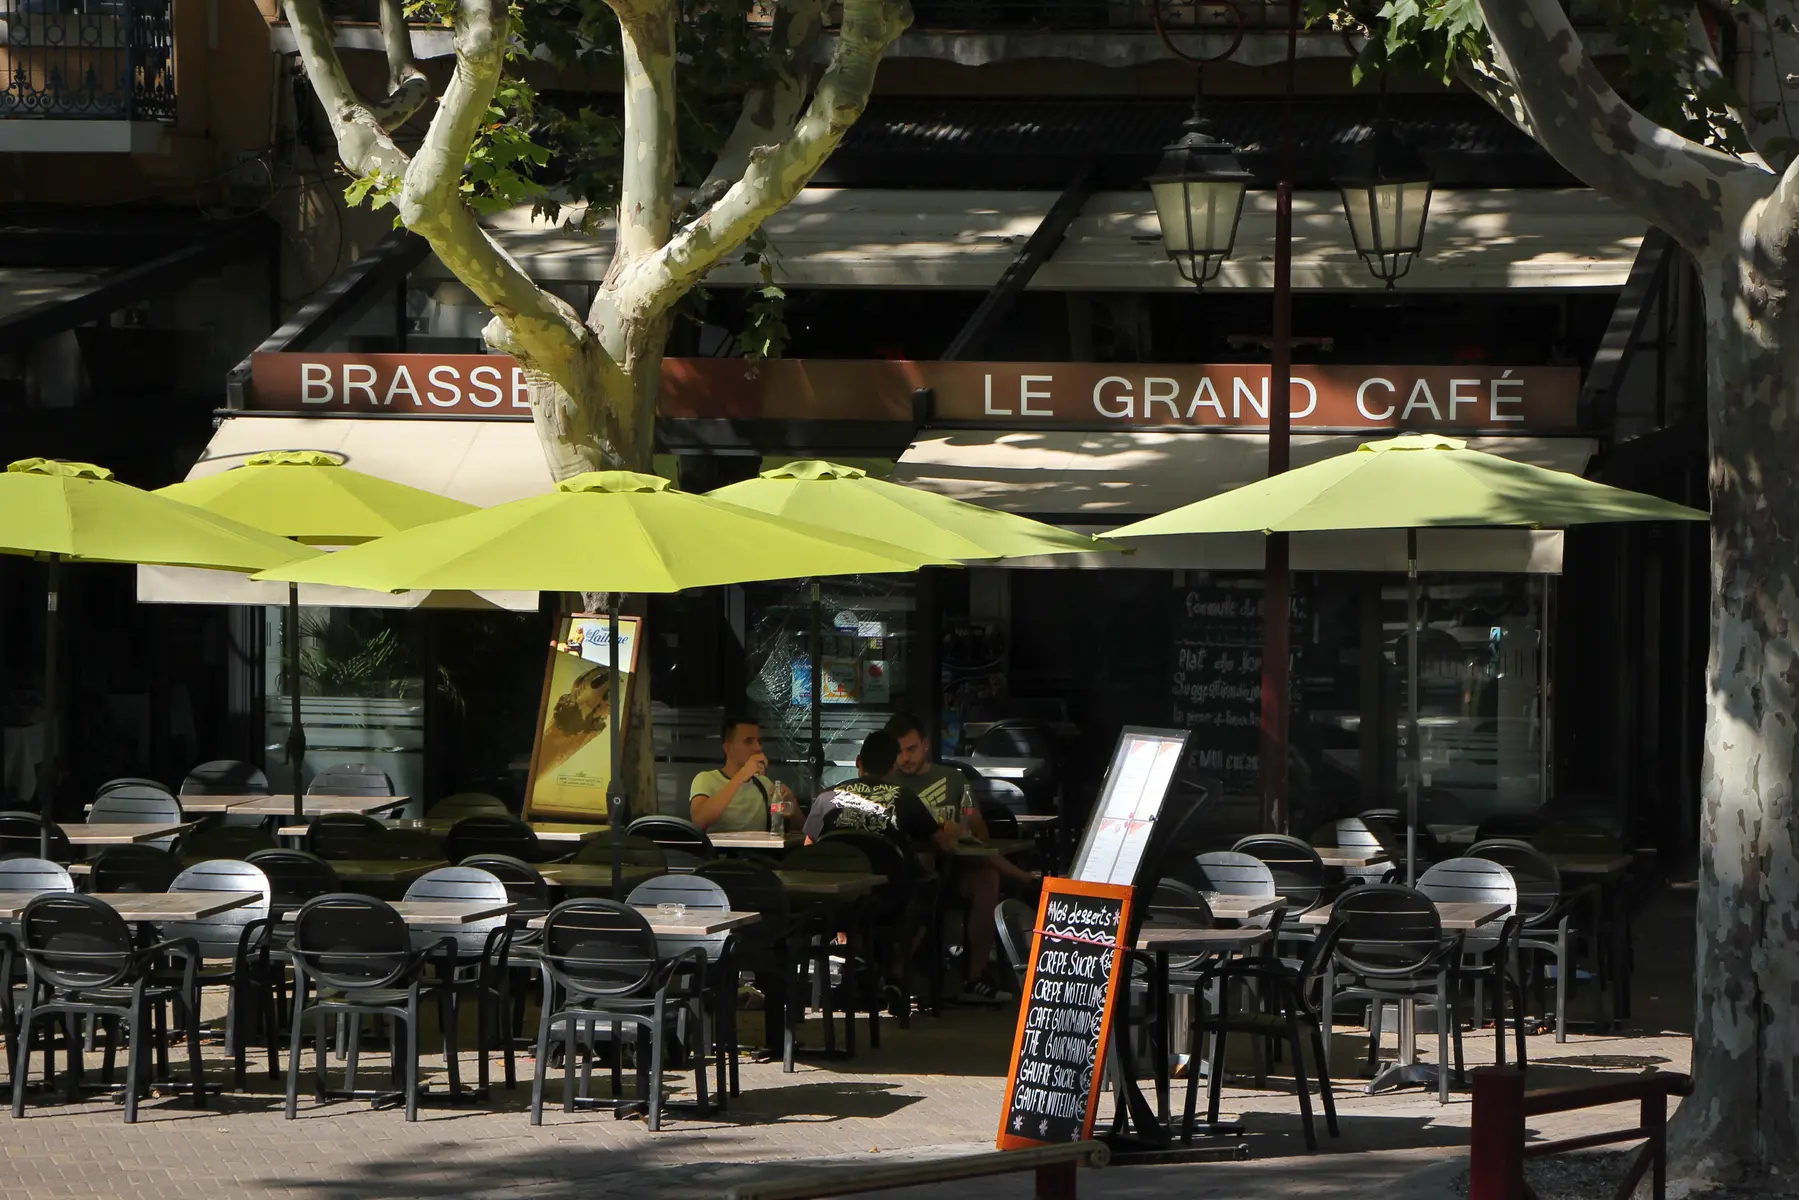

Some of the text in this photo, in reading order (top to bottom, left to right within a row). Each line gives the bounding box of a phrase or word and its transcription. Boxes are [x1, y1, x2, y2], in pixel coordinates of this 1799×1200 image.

[301, 363, 530, 408] BRASSE
[984, 370, 1525, 421] LE GRAND CAFÉ
[1179, 648, 1207, 672] Plat
[1050, 901, 1112, 926] Nos desserts
[1039, 950, 1069, 975] CREPE
[1068, 950, 1098, 978] SUCRE
[1034, 978, 1063, 1003] CREPE
[1029, 1007, 1052, 1029] CAFE
[1051, 1008, 1092, 1034] GOURMAND
[1022, 1030, 1042, 1056] THE
[1045, 1031, 1086, 1064] GOURMAND
[1020, 1058, 1052, 1086] GAUFRE
[1052, 1065, 1077, 1089] SUCRE
[1014, 1085, 1048, 1114] GAUFRE
